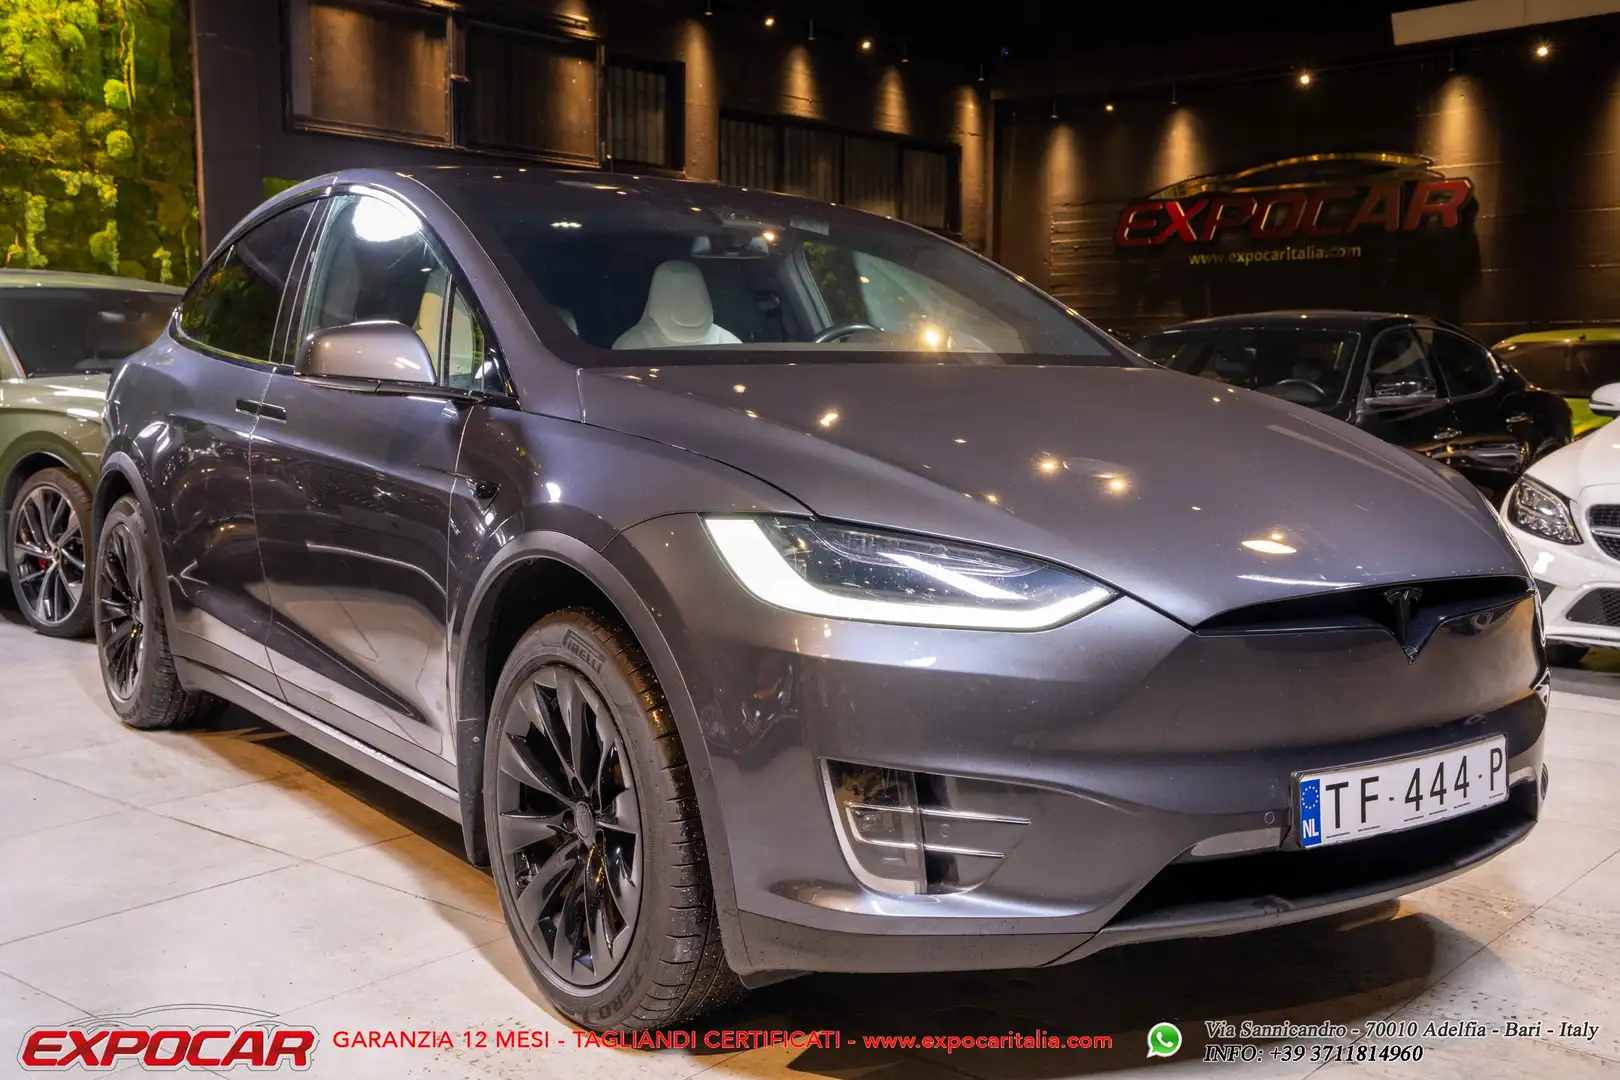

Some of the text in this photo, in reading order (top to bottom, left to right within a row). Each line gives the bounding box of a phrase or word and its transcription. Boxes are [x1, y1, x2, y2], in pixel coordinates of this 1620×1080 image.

[1115, 177, 1474, 246] EXPOCAR
[1188, 245, 1362, 267] www.expocaritalia.com
[1302, 818, 1320, 839] NL
